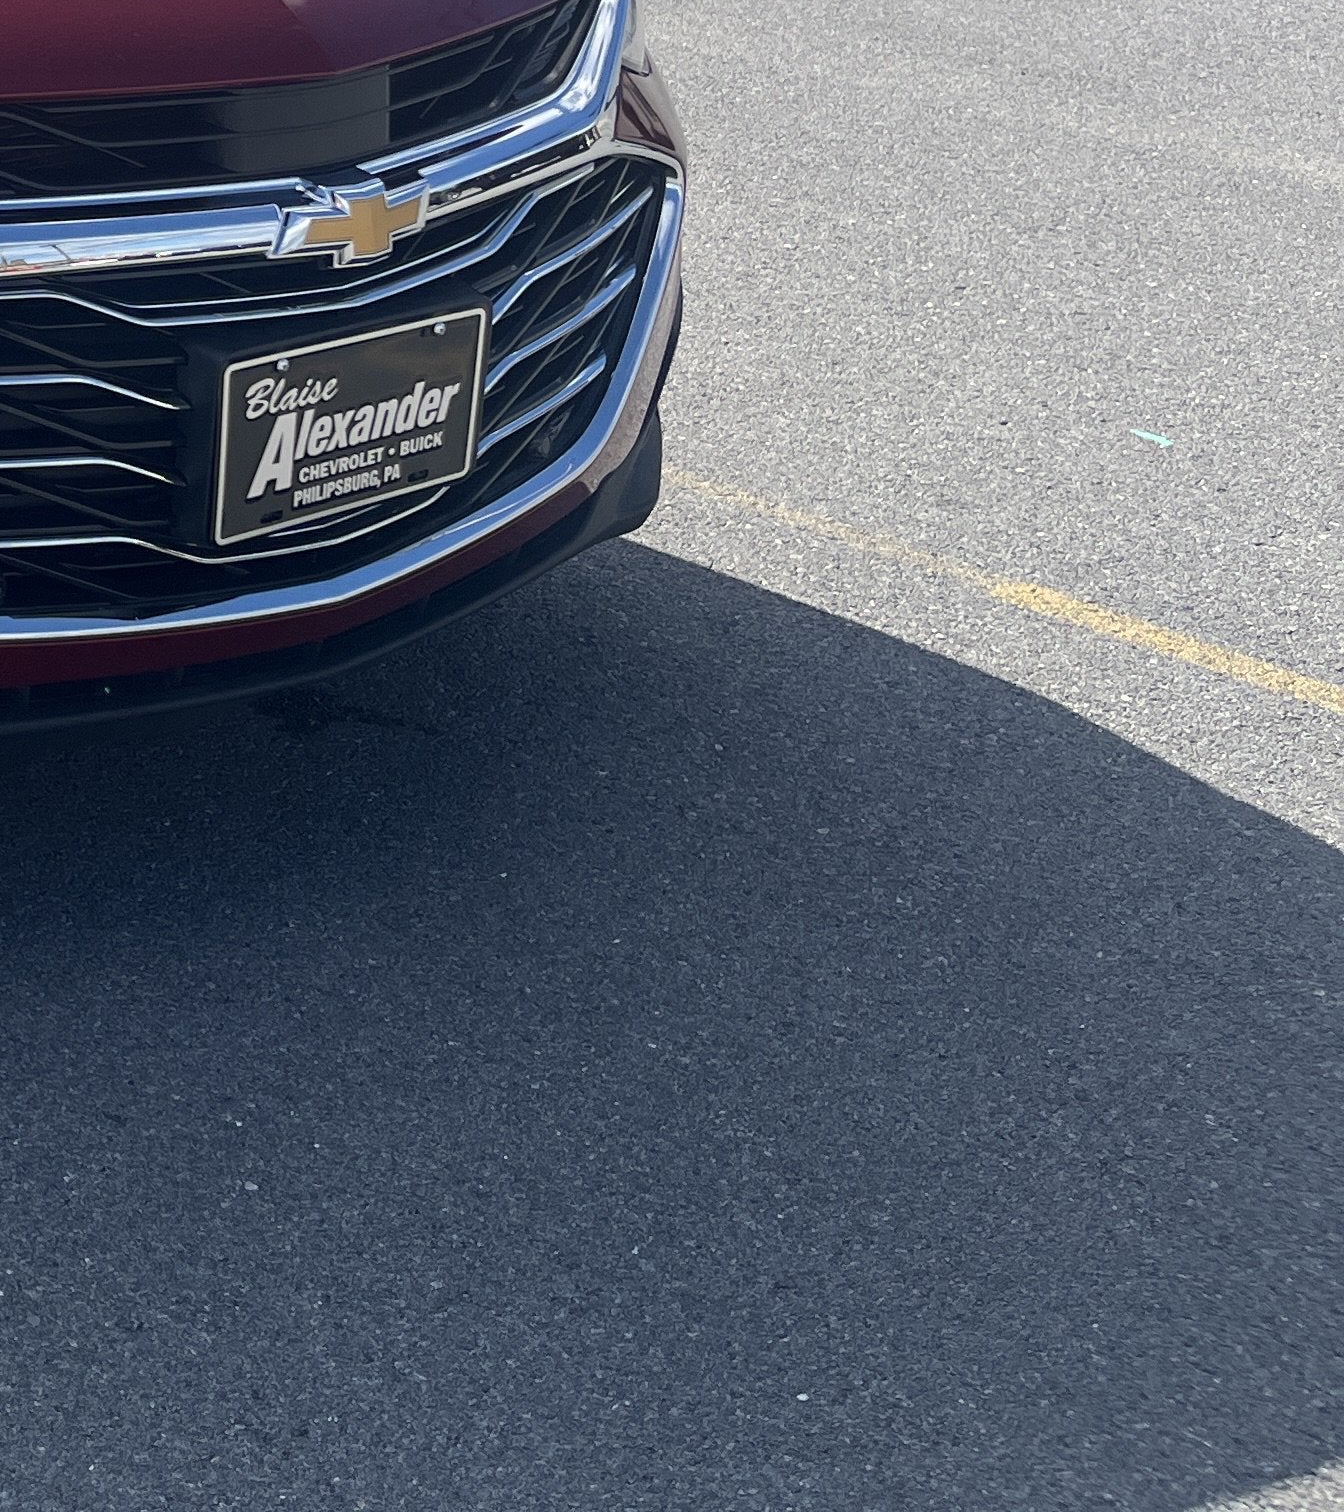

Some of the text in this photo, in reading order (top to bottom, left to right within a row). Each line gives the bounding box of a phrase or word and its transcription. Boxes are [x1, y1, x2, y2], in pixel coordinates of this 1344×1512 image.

[245, 378, 338, 419] Blaise
[246, 381, 461, 499] Alexander
[298, 431, 444, 483] CHEVROLET BUICK
[293, 464, 401, 508] PHILIPSBURG, PA
